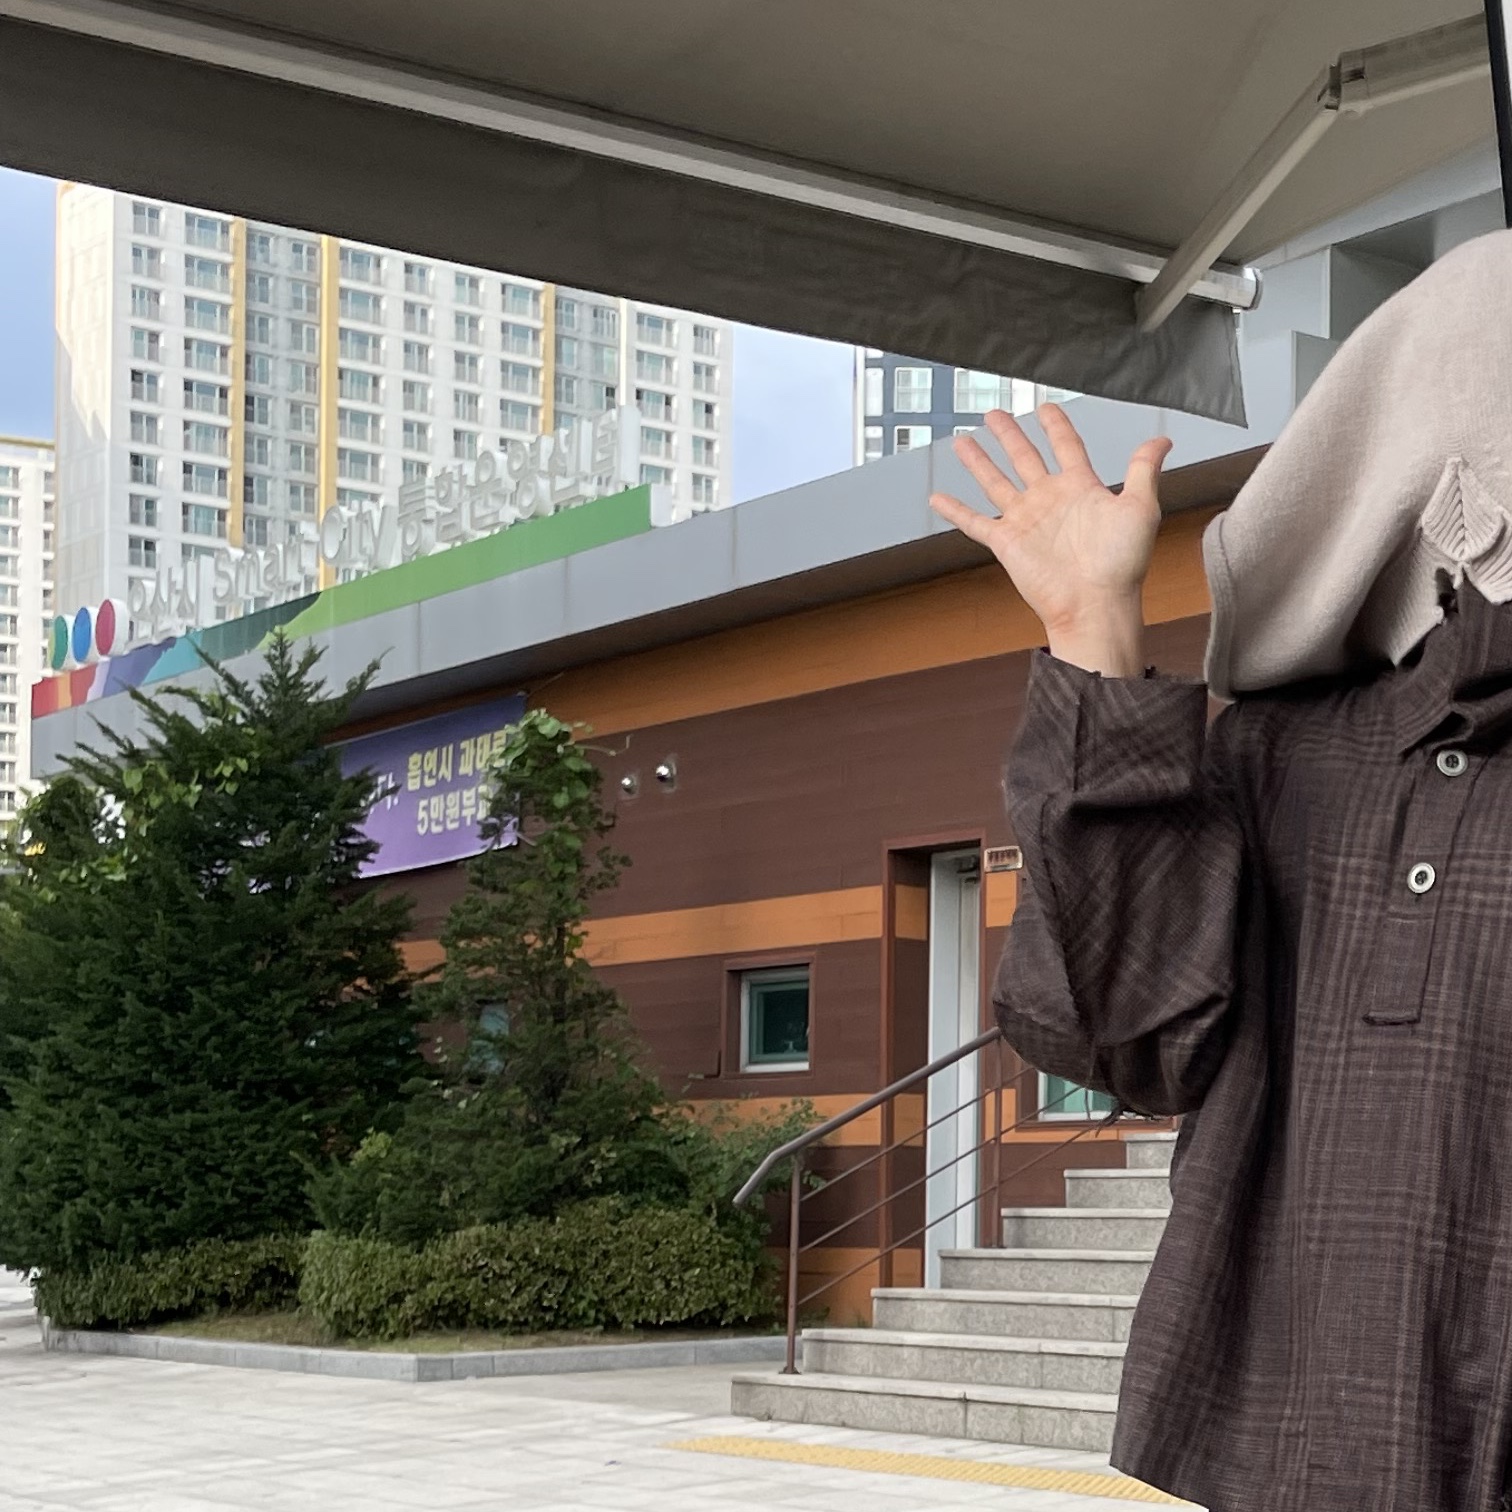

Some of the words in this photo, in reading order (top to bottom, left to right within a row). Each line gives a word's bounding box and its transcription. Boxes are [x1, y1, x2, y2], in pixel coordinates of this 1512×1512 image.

[213, 531, 314, 602] Smart
[320, 499, 402, 572] City
[407, 743, 454, 792] 흡연시
